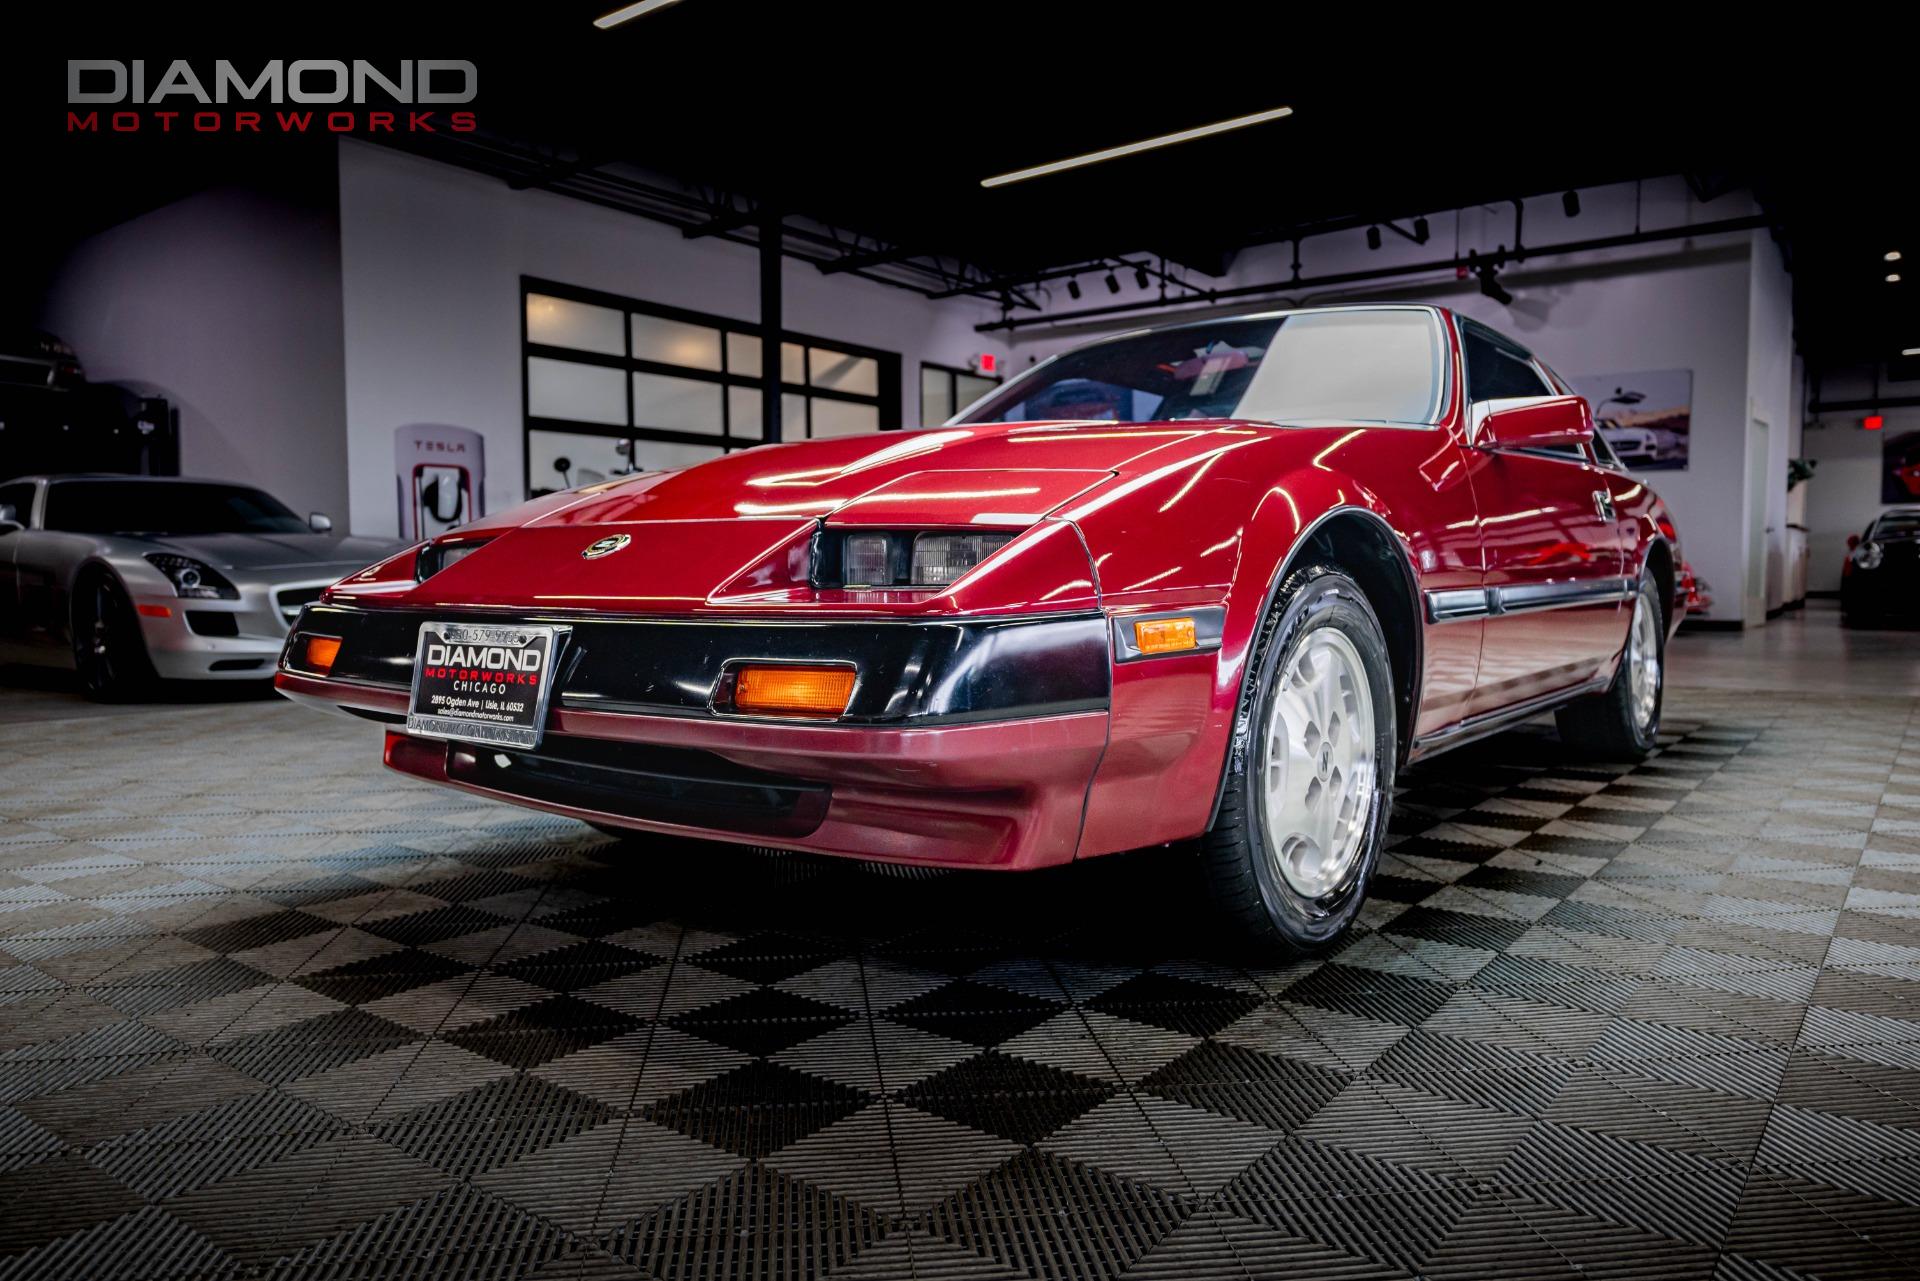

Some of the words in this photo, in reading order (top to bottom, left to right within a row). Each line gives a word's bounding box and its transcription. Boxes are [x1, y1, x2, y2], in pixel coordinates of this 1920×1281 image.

[414, 439, 466, 453] TESLA
[427, 644, 542, 672] DIAMOND
[424, 667, 538, 686] MOTORWORKS
[453, 680, 506, 695] CHICAGO
[431, 695, 446, 705] 2895
[446, 696, 466, 707] Ogden
[467, 698, 480, 708] Ave
